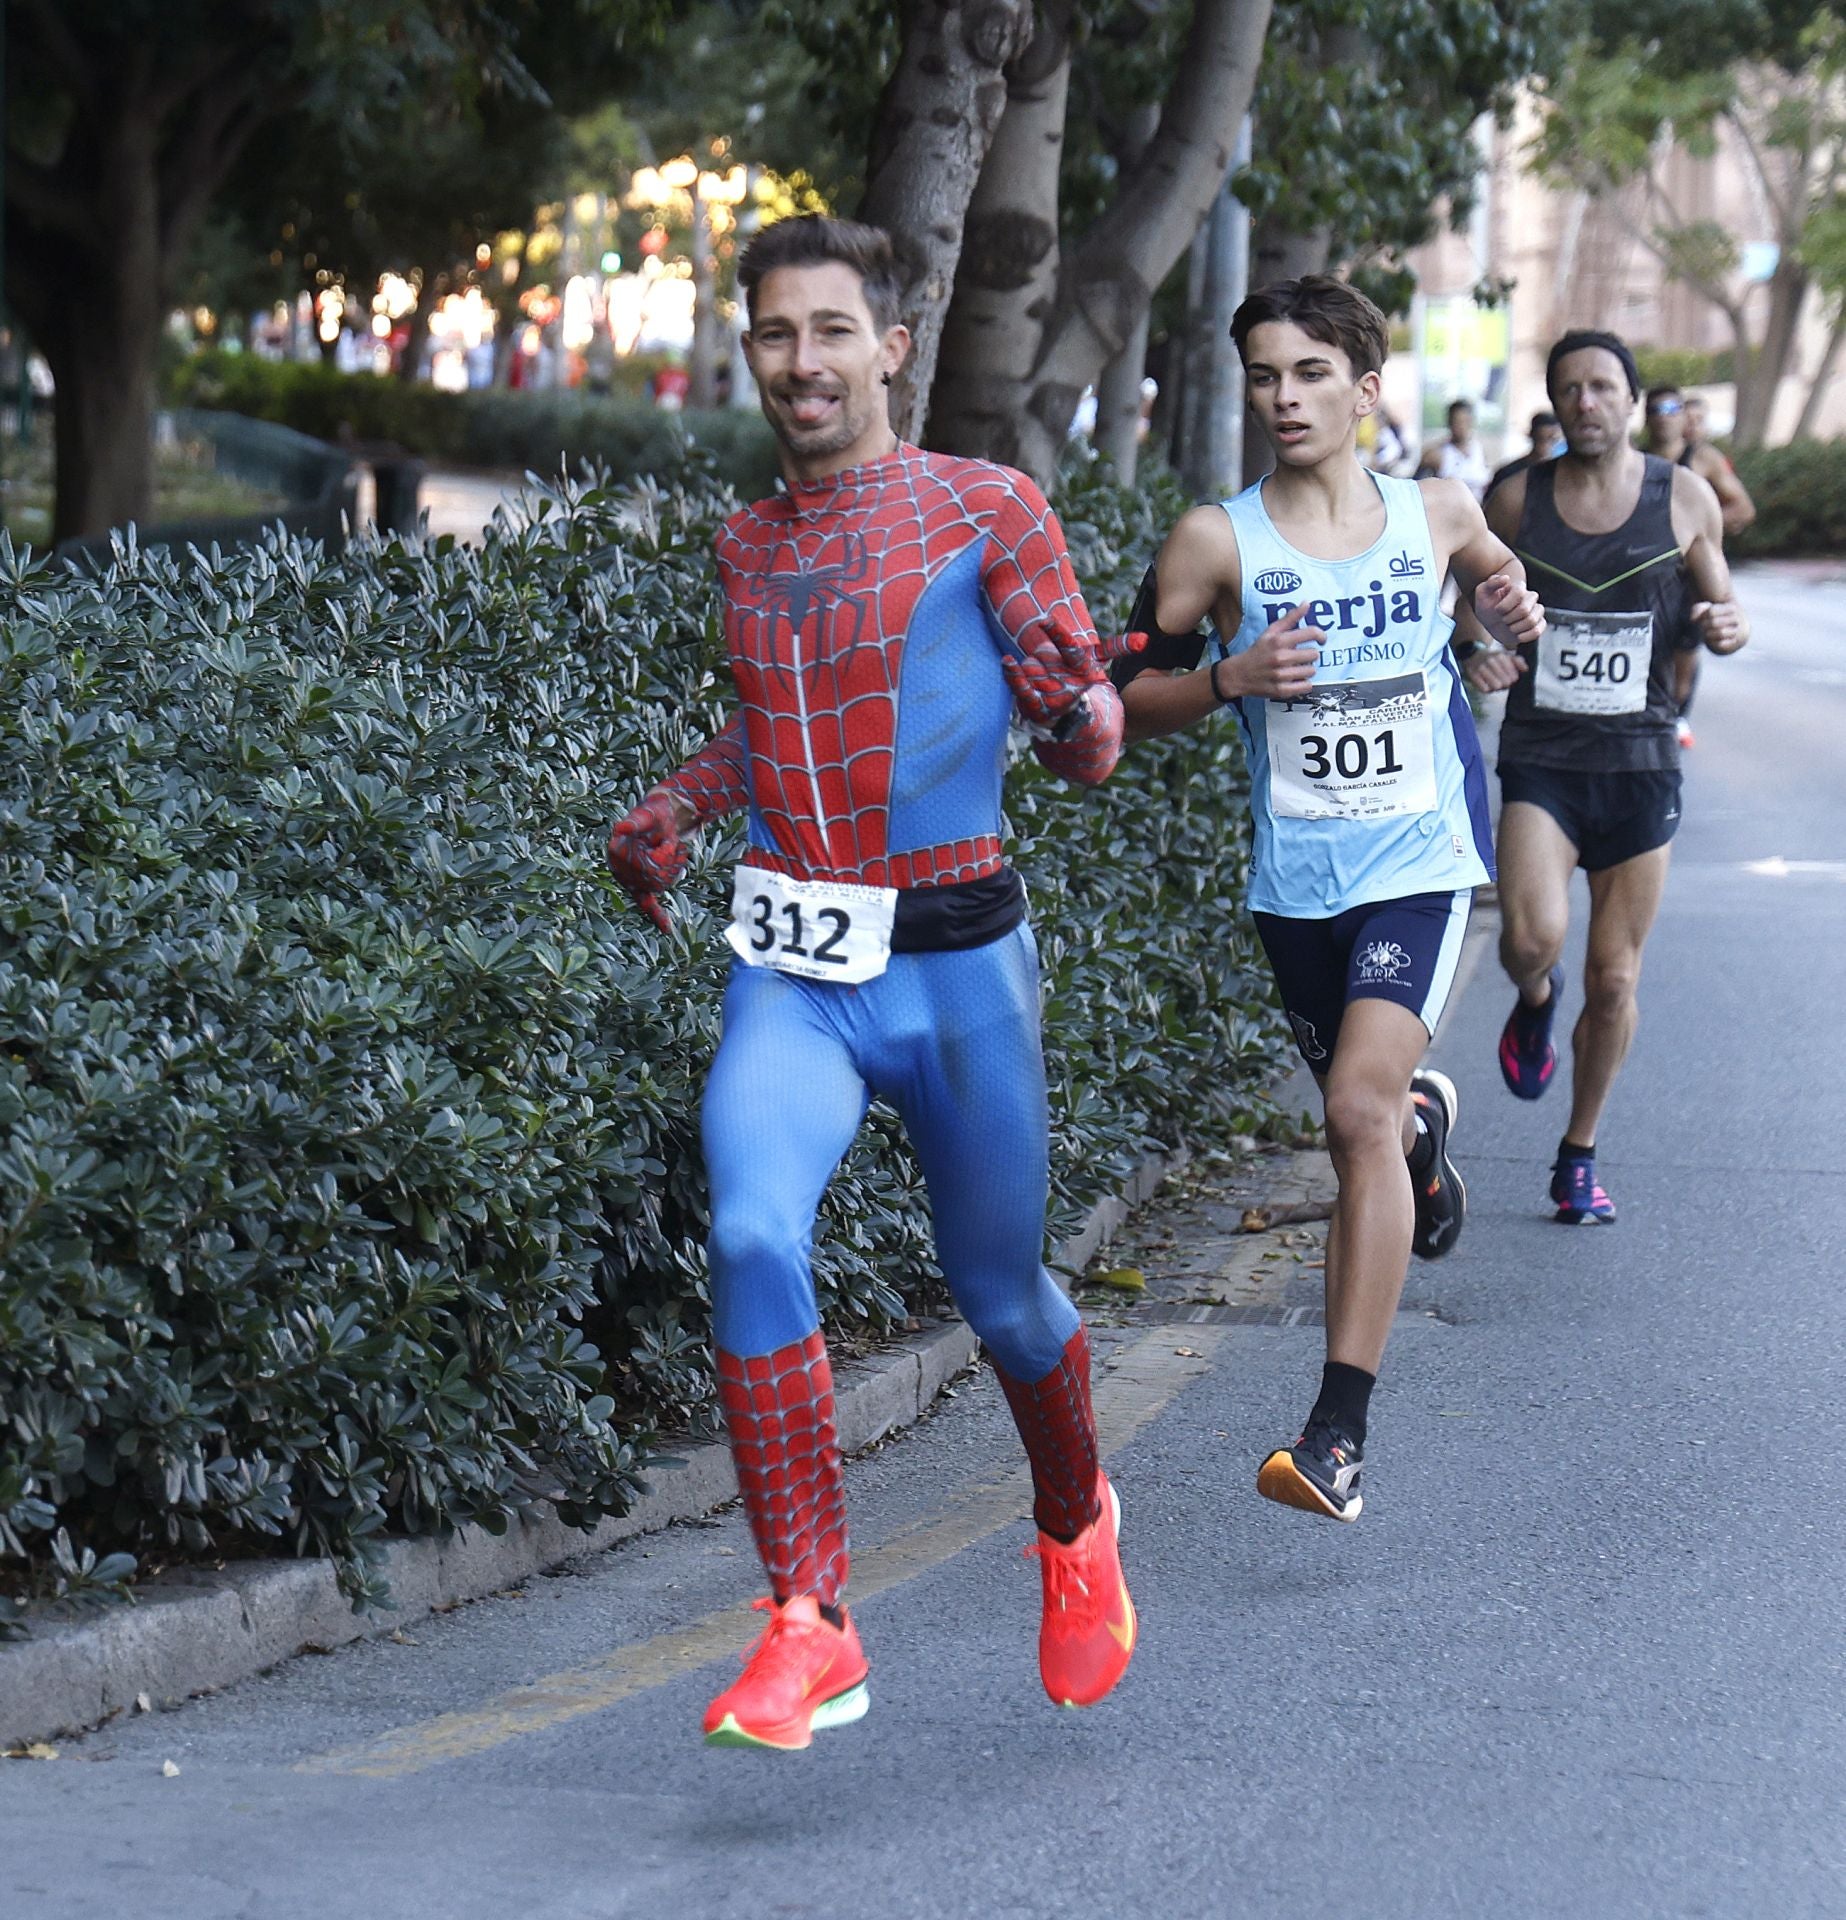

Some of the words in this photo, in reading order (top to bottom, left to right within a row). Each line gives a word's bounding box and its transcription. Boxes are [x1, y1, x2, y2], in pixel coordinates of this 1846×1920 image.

[1389, 550, 1425, 577] als
[1255, 571, 1301, 591] TROPS
[1262, 580, 1423, 638] nerja
[1319, 641, 1405, 668] LETISMO
[1557, 649, 1630, 683] 540
[1369, 702, 1424, 715] CARRERA
[1376, 690, 1426, 708] XIV
[1313, 720, 1357, 728] PALMA
[1362, 711, 1424, 724] PALMILLA
[1365, 707, 1424, 720] SILVESTRE
[1300, 730, 1403, 780] 301
[751, 894, 850, 965] 312
